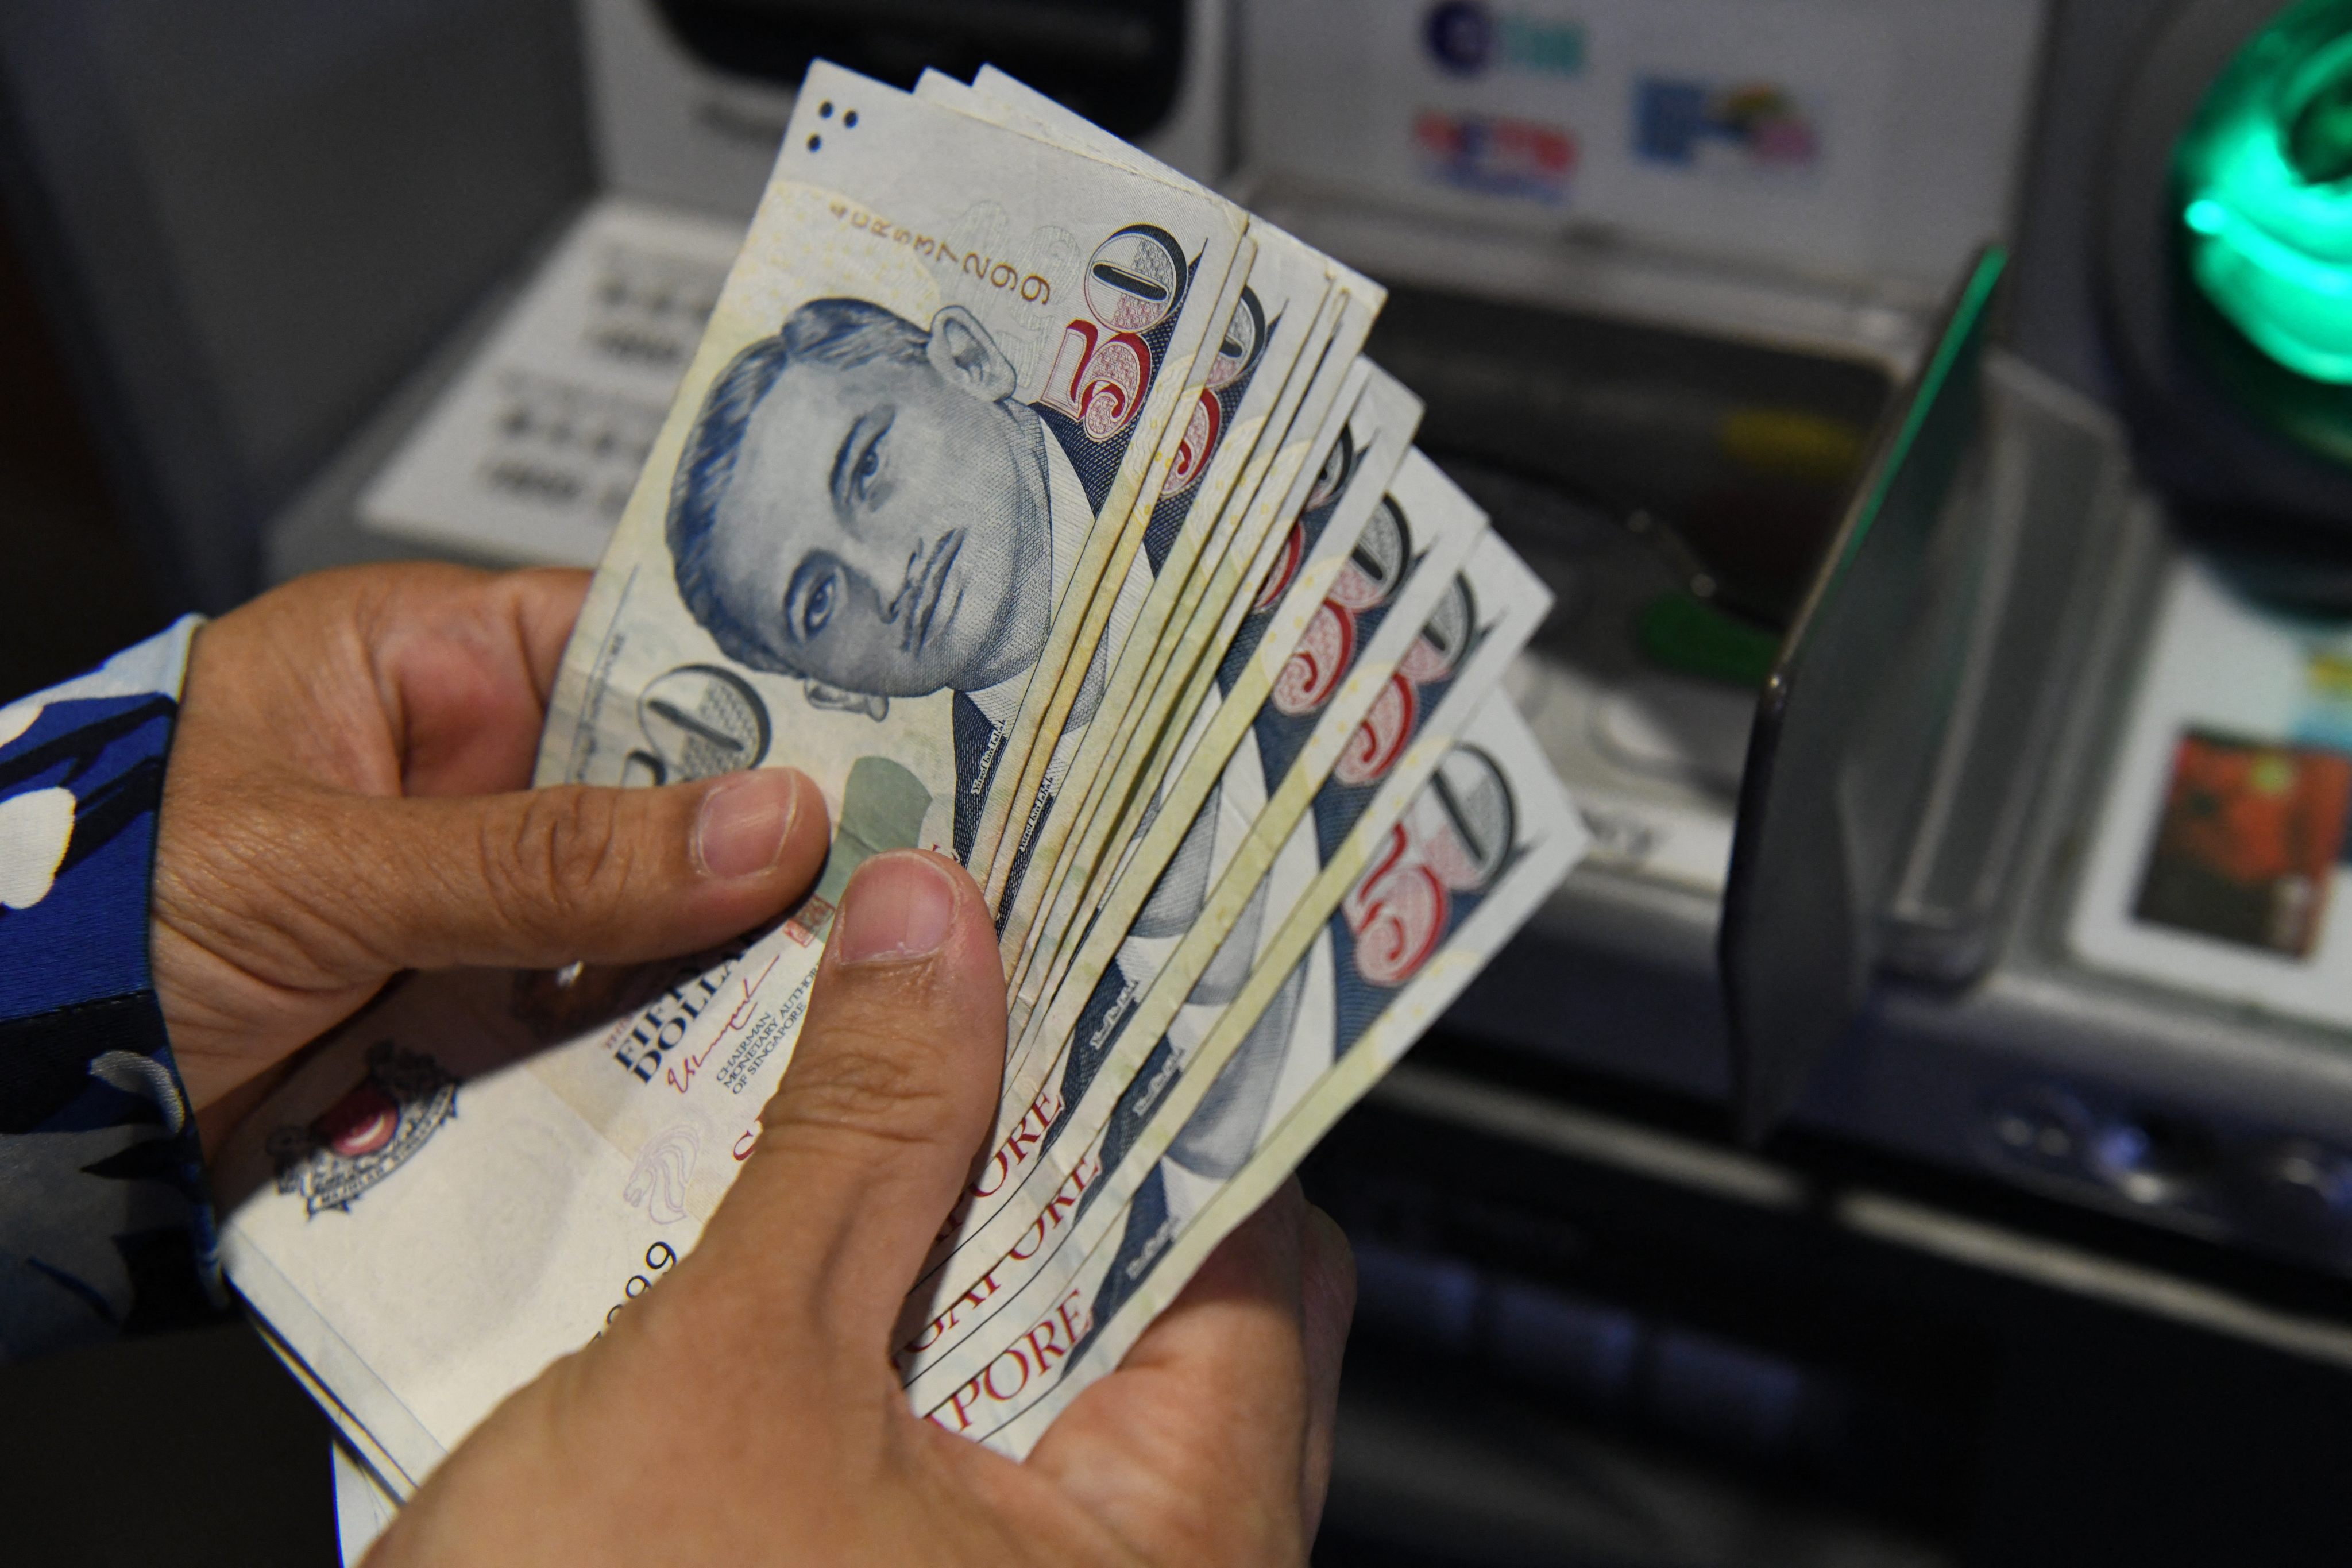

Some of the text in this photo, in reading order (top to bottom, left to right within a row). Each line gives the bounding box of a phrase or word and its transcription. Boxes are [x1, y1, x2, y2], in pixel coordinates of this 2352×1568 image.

[1040, 222, 1189, 442] 50
[716, 1011, 771, 1082] CHAIRMAN
[724, 1018, 778, 1088] MONETARY
[732, 1074, 748, 1095] OF
[747, 1002, 806, 1076] SINGAPORE
